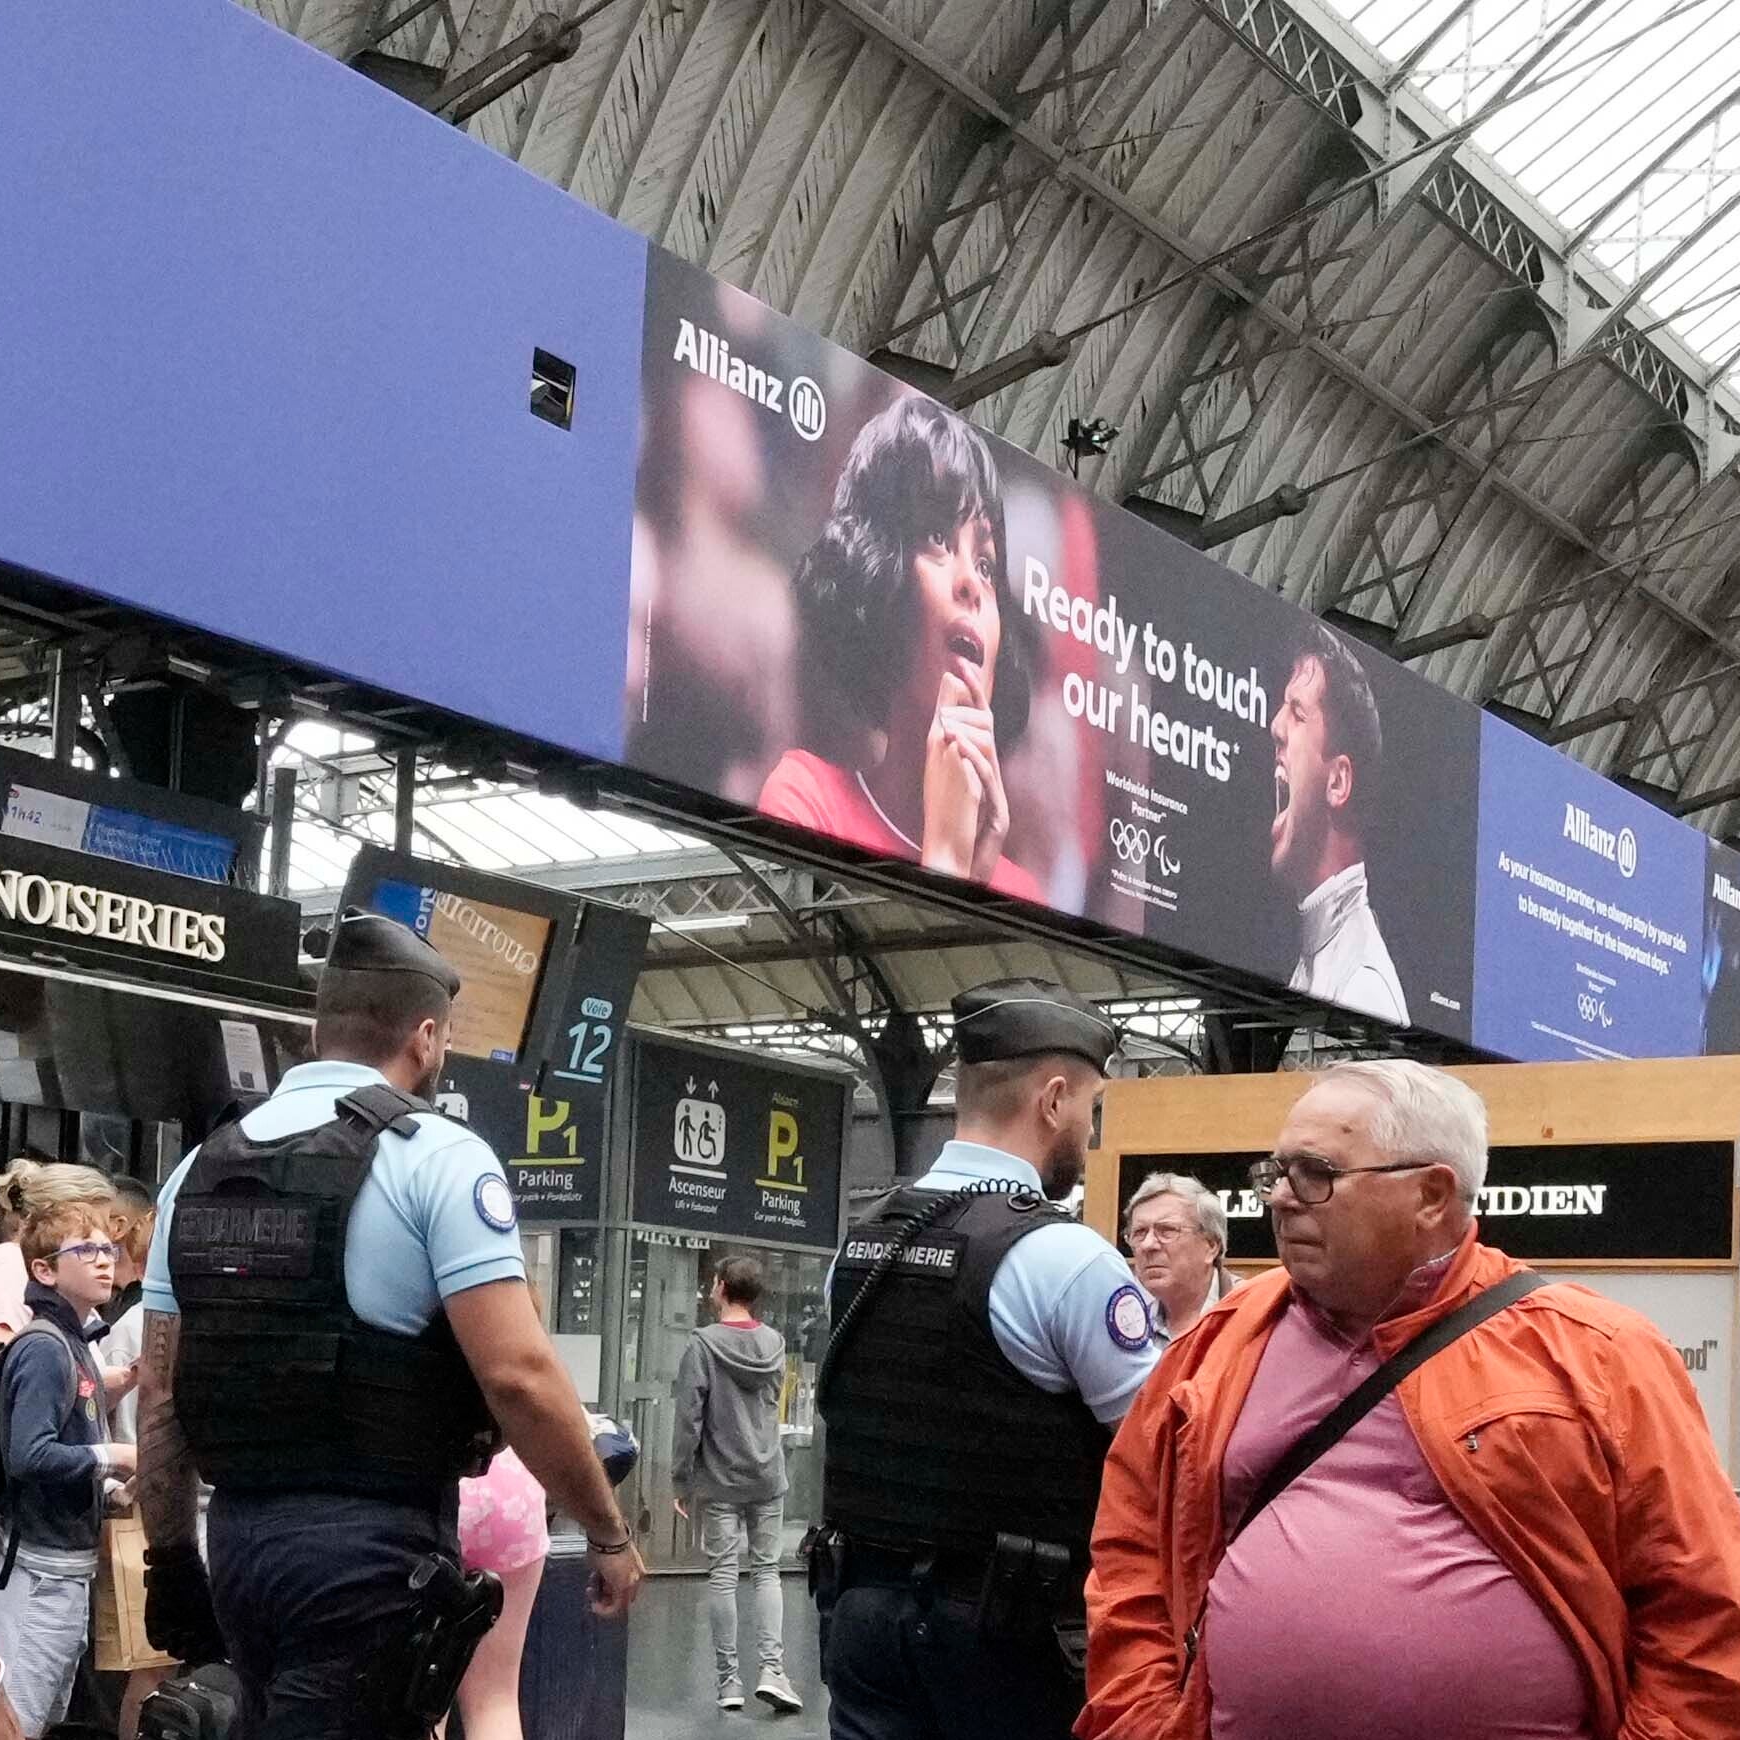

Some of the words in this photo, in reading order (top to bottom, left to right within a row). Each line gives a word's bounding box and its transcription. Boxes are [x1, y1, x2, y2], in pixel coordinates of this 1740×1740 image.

[673, 318, 783, 413] Allianz
[1023, 555, 1138, 674] Ready
[1143, 622, 1177, 683] to
[1183, 642, 1268, 729] touch
[1063, 672, 1123, 734] our
[1105, 768, 1150, 799] Worldwide
[1150, 788, 1188, 815] Insurance
[1564, 802, 1616, 861] Allianz
[1498, 851, 1510, 873] As
[1510, 859, 1529, 880] your
[1529, 863, 1566, 897] insurance
[1566, 883, 1595, 914] partner,
[1596, 901, 1607, 918] we
[1608, 903, 1633, 929] always
[1632, 915, 1649, 938] stay
[1647, 927, 1657, 945] by
[1657, 931, 1674, 948] your
[1673, 932, 1687, 954] side
[1518, 893, 1527, 912] to
[1528, 895, 1539, 918] be
[1538, 904, 1561, 931] ready
[1561, 913, 1593, 943] together
[1592, 925, 1604, 946] for
[1604, 932, 1617, 952] the
[1617, 936, 1651, 968] important
[586, 1000, 609, 1017] Voie
[569, 1022, 612, 1074] 12
[767, 1110, 805, 1185] P1
[518, 1170, 574, 1190] Parking
[668, 1176, 727, 1201] Ascenseur
[762, 1190, 801, 1216] Parking
[1217, 1190, 1264, 1218] LE
[1472, 1184, 1607, 1215] TIDIEN
